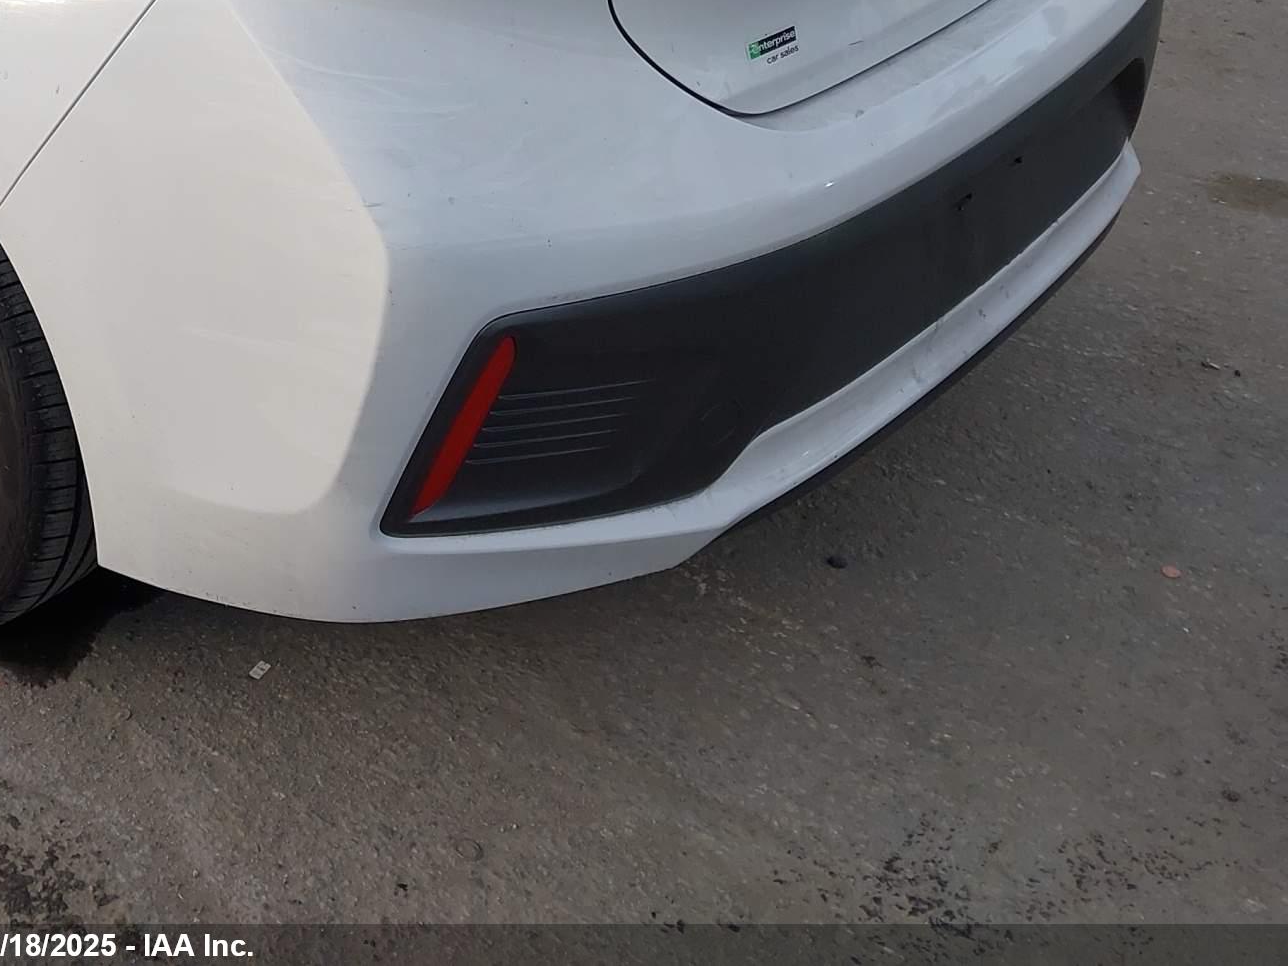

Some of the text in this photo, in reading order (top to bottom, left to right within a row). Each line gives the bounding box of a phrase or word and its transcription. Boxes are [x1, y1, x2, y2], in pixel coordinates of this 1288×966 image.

[750, 30, 797, 54] enterprise
[766, 45, 799, 64] car sales
